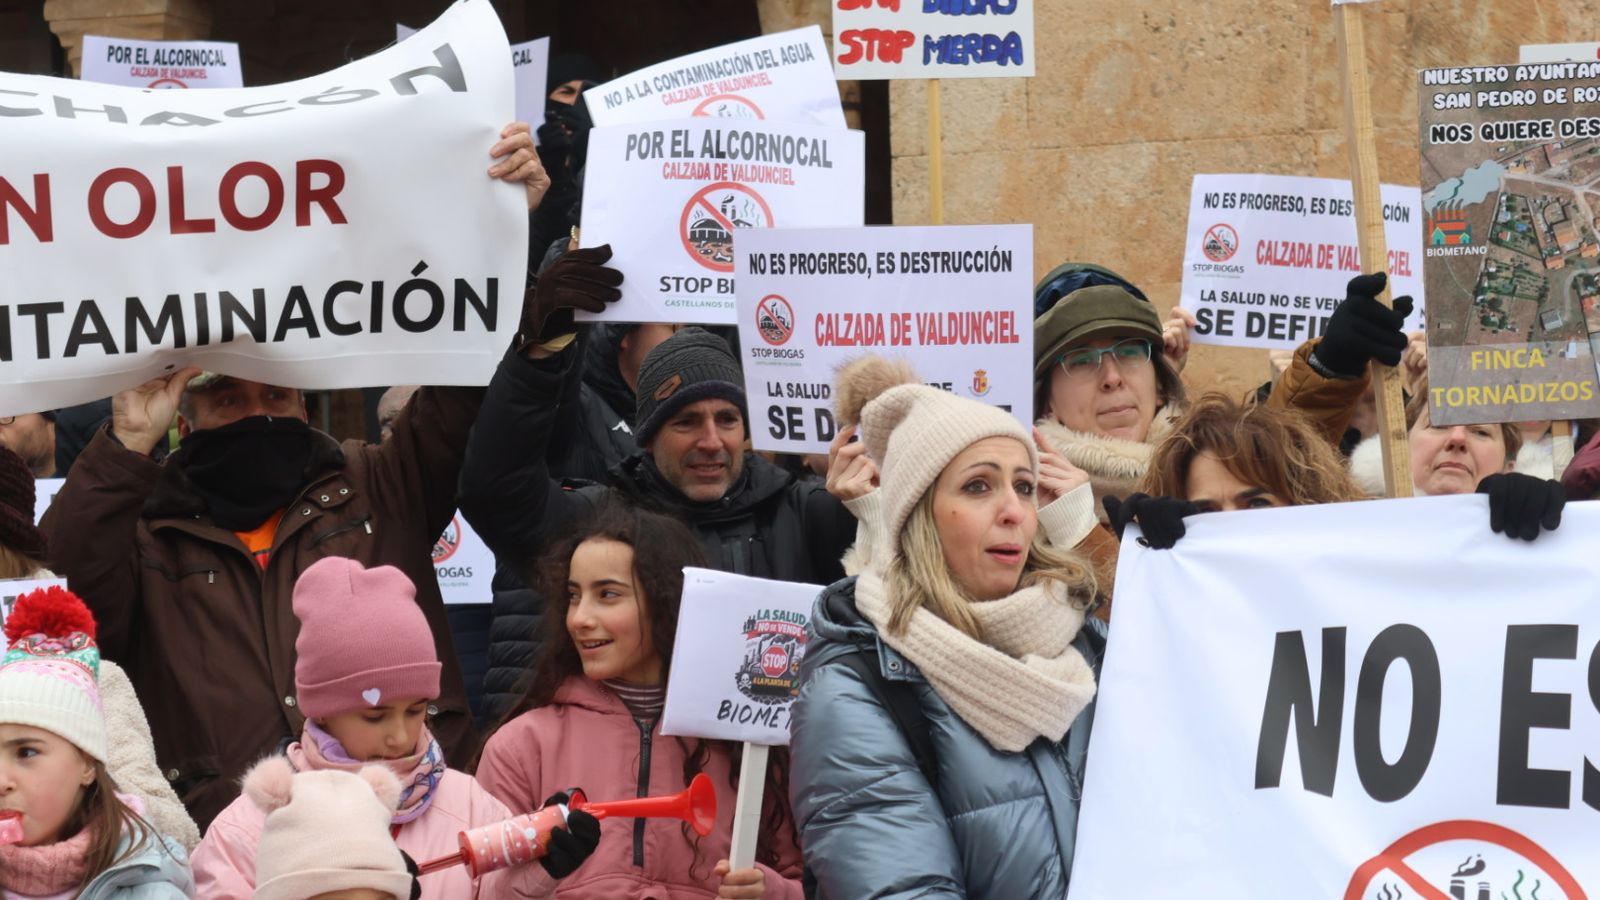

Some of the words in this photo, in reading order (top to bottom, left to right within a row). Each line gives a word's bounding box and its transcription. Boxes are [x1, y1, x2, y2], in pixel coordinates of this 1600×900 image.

[107, 45, 132, 64] POR
[136, 47, 149, 64] EL
[153, 48, 227, 66] ALCORNOCAL
[837, 28, 915, 65] STOP
[922, 31, 1023, 66] MIERDA
[130, 66, 159, 78] CALZADA
[160, 67, 169, 78] DE
[603, 94, 623, 110] NO
[624, 90, 634, 105] A
[635, 84, 651, 101] LA
[653, 53, 752, 95] CONTAMINACIÓN
[754, 50, 779, 72] DEL
[780, 42, 815, 66] AGUA
[1424, 66, 1509, 85] NUESTRO
[661, 85, 704, 106] CALZADA
[705, 81, 721, 97] DE
[722, 73, 772, 95] VALDUNCIEL
[1433, 92, 1471, 110] SAN
[1477, 90, 1536, 108] PEDRO
[1543, 88, 1567, 104] DE
[1430, 122, 1473, 143] NOS
[1481, 119, 1553, 141] QUIERE
[625, 130, 664, 161] POR
[670, 129, 694, 159] EL
[700, 129, 832, 168] ALCORNOCAL
[662, 162, 711, 181] CALZADA
[714, 163, 728, 181] DE
[732, 163, 795, 186] VALDUNCIEL
[87, 158, 348, 240] OLOR
[1203, 192, 1219, 209] NO
[1222, 193, 1236, 209] ES
[1239, 193, 1307, 217] PROGRESO,
[1310, 197, 1326, 214] ES
[749, 252, 767, 275] NO
[770, 252, 785, 275] ES
[789, 251, 872, 279] PROGRESO,
[875, 251, 895, 274] ES
[900, 245, 1012, 274] DESTRUCCIÓN
[1256, 239, 1313, 267] CALZADA
[1317, 244, 1333, 270] DE
[1427, 245, 1487, 257] BIOMETANO
[1193, 263, 1212, 271] STOP
[1214, 264, 1245, 273] BIOGAS
[659, 276, 712, 294] STOP
[665, 299, 722, 309] CASTELLANOS
[1200, 289, 1217, 303] LA
[1221, 291, 1265, 306] SALUD
[1270, 294, 1289, 307] NO
[1294, 295, 1311, 309] SE
[814, 312, 885, 347] CALZADA
[891, 312, 912, 346] DE
[916, 310, 1019, 346] VALDUNCIEL
[1195, 308, 1235, 337] SE
[752, 348, 772, 358] STOP
[773, 348, 805, 359] BIOGAS
[1471, 347, 1547, 371] FINCA
[767, 381, 784, 397] LA
[787, 382, 831, 400] SALUD
[1431, 380, 1593, 408] TORNADIZOS
[768, 405, 806, 441] SE
[757, 609, 770, 621] LA
[772, 610, 806, 625] SALUD
[758, 622, 769, 632] NO
[778, 623, 802, 636] VENDE
[763, 653, 786, 669] STOP
[1255, 623, 1442, 803] NO
